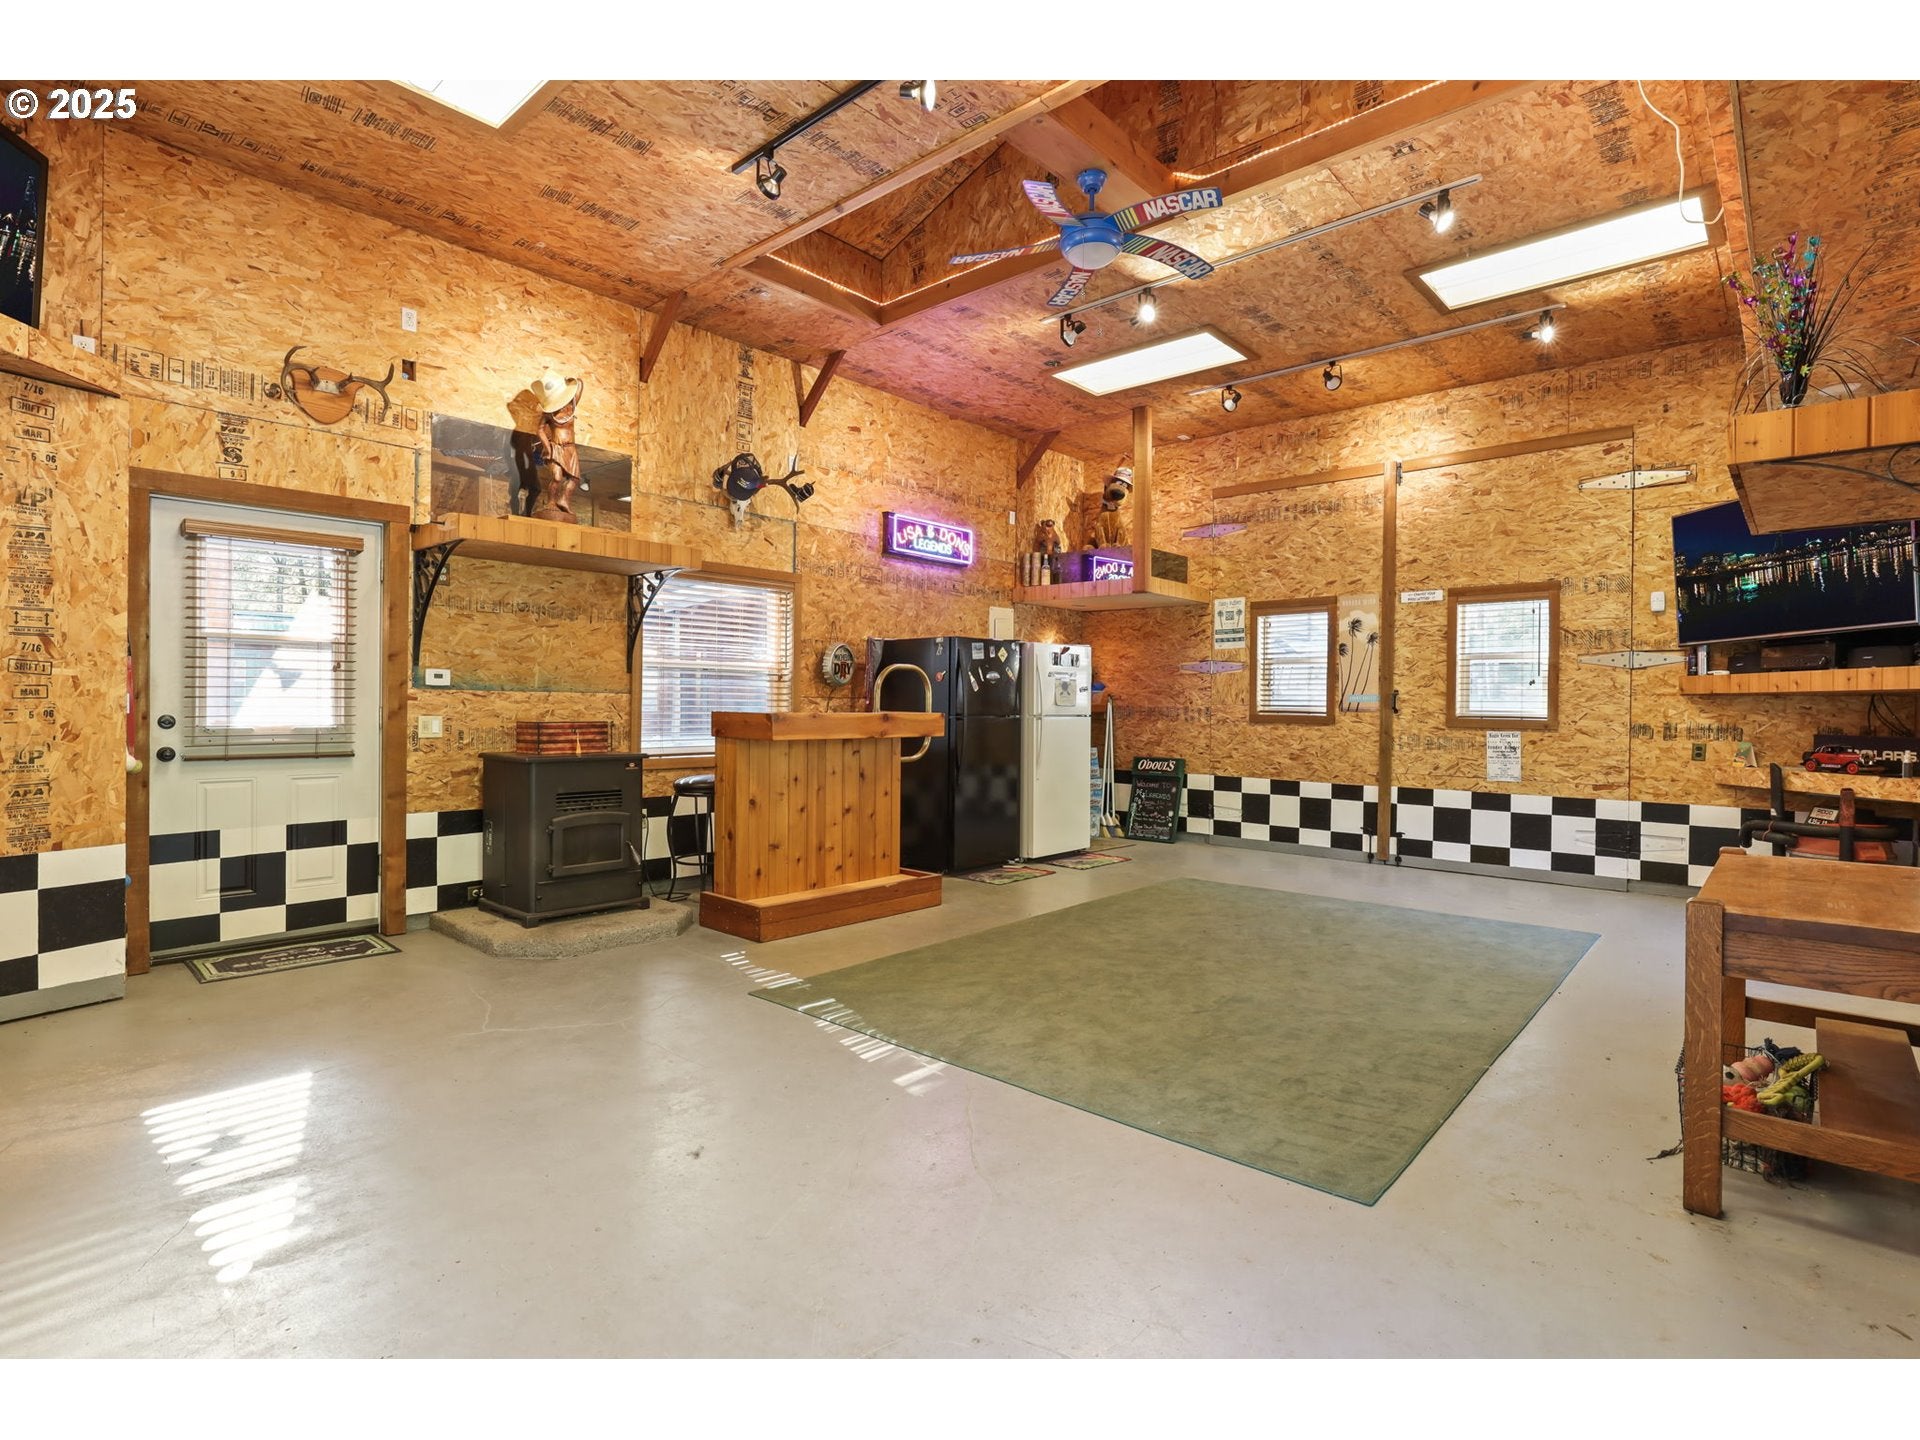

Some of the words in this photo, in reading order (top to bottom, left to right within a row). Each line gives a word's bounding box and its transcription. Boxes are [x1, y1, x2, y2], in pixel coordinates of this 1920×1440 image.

[1142, 190, 1219, 221] NASCAR
[951, 248, 1023, 265] NASCAR
[1153, 245, 1213, 278] NASCAR
[1049, 272, 1091, 306] NASCAR
[24, 382, 44, 395] 7/16
[16, 401, 41, 413] SHIFT
[22, 428, 42, 438] MAR
[45, 454, 57, 463] 06
[12, 531, 46, 540] APA
[897, 525, 923, 544] LISA
[927, 525, 935, 537] &
[913, 538, 952, 555] LEGENDS
[21, 642, 42, 653] 7/16
[14, 662, 39, 671] SHIFT
[42, 664, 46, 672] 1
[834, 662, 852, 677] DRY
[43, 709, 54, 718] 06
[1138, 759, 1176, 771] O'DOUL'S
[11, 788, 44, 798] APA
